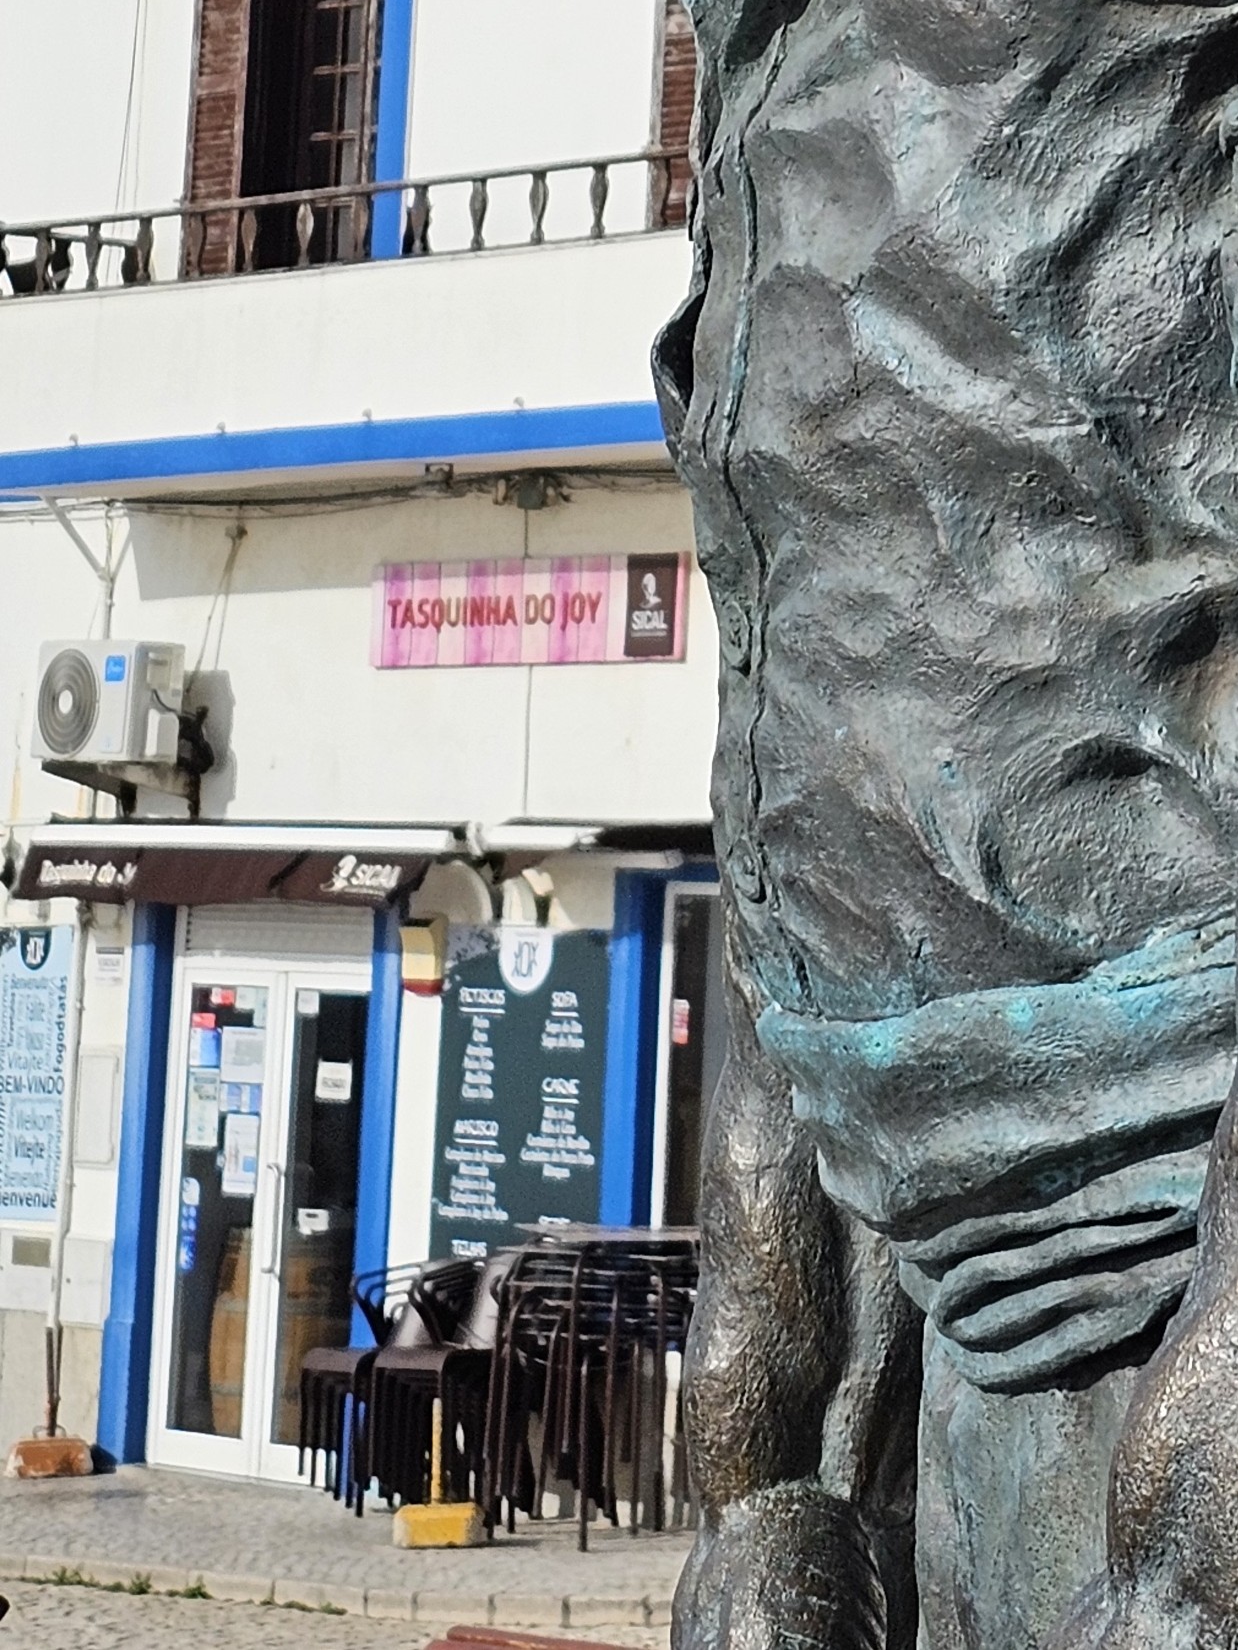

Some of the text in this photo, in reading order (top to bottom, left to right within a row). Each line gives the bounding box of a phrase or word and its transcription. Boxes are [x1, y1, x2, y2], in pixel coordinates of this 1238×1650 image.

[388, 591, 603, 633] TASQUINHA DO JOY
[631, 609, 669, 630] SICAL
